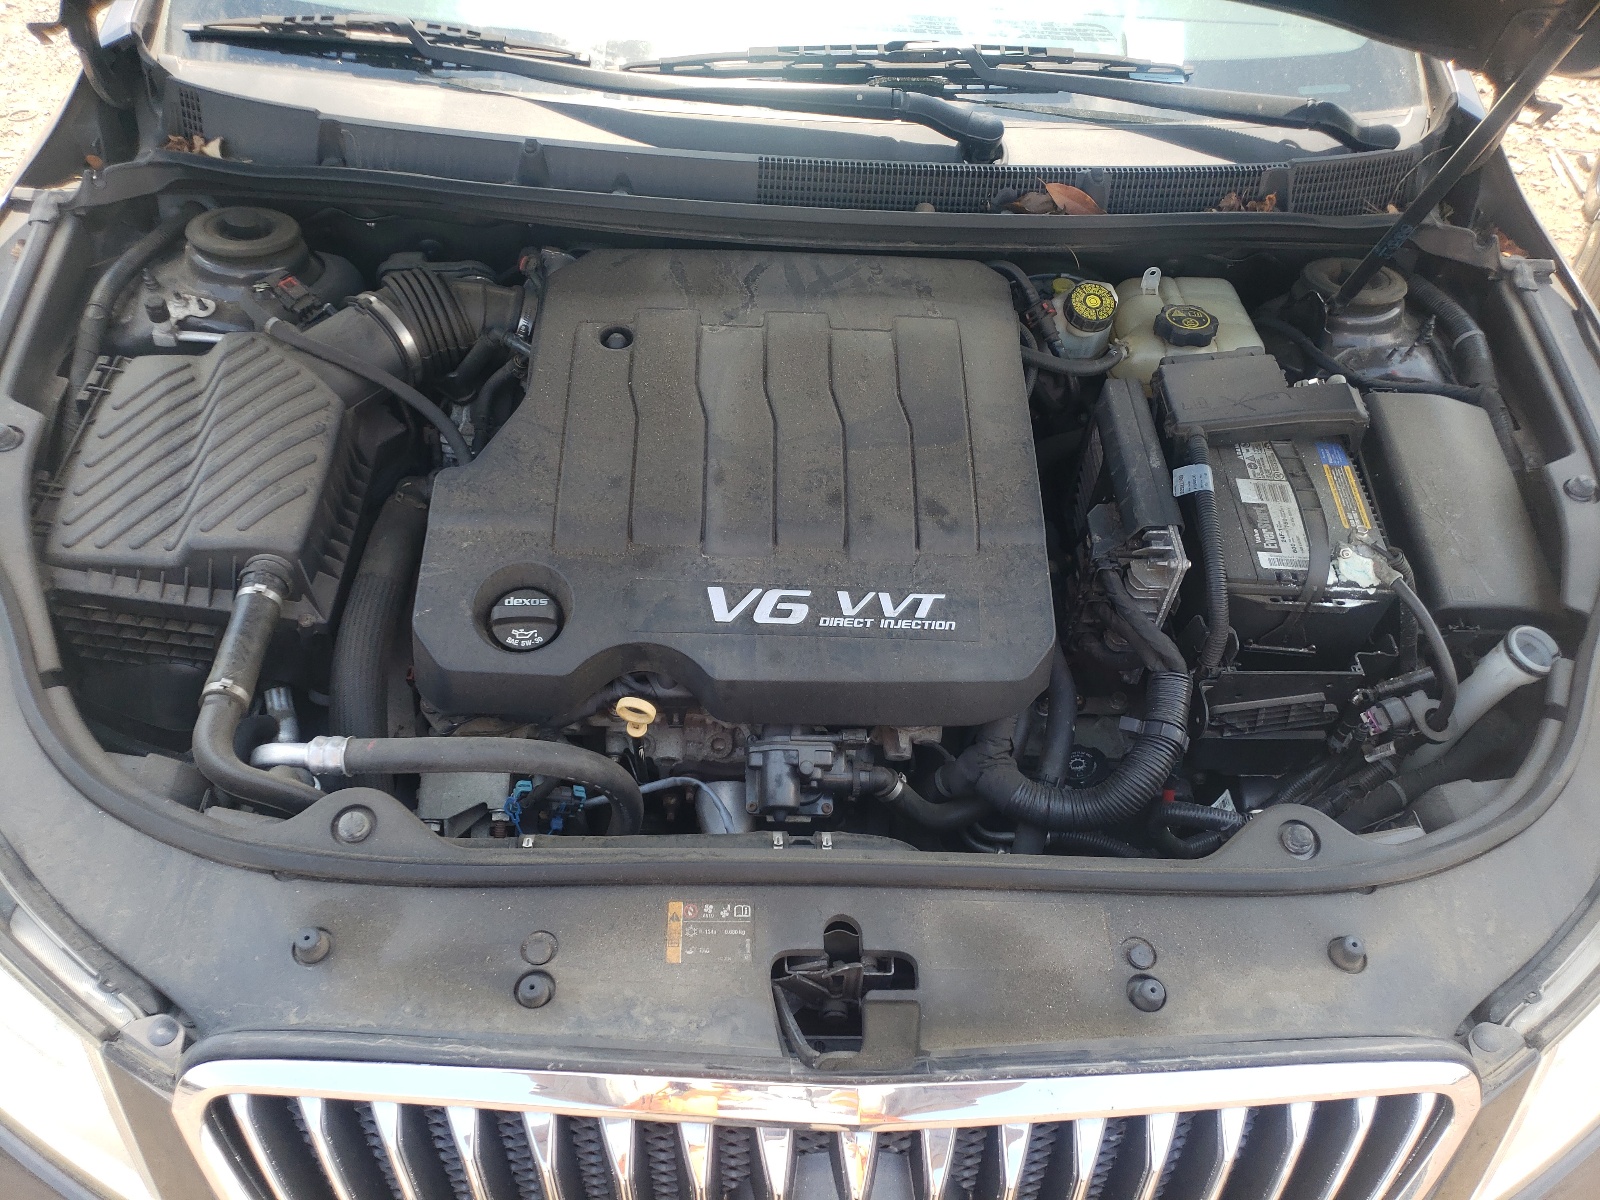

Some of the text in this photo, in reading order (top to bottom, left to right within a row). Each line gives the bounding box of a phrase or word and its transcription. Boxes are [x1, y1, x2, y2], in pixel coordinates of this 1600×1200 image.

[504, 596, 550, 606] dexos
[707, 586, 946, 625] V6 VVT
[818, 617, 956, 631] DIRECT INJECTION
[505, 636, 519, 646] SAE
